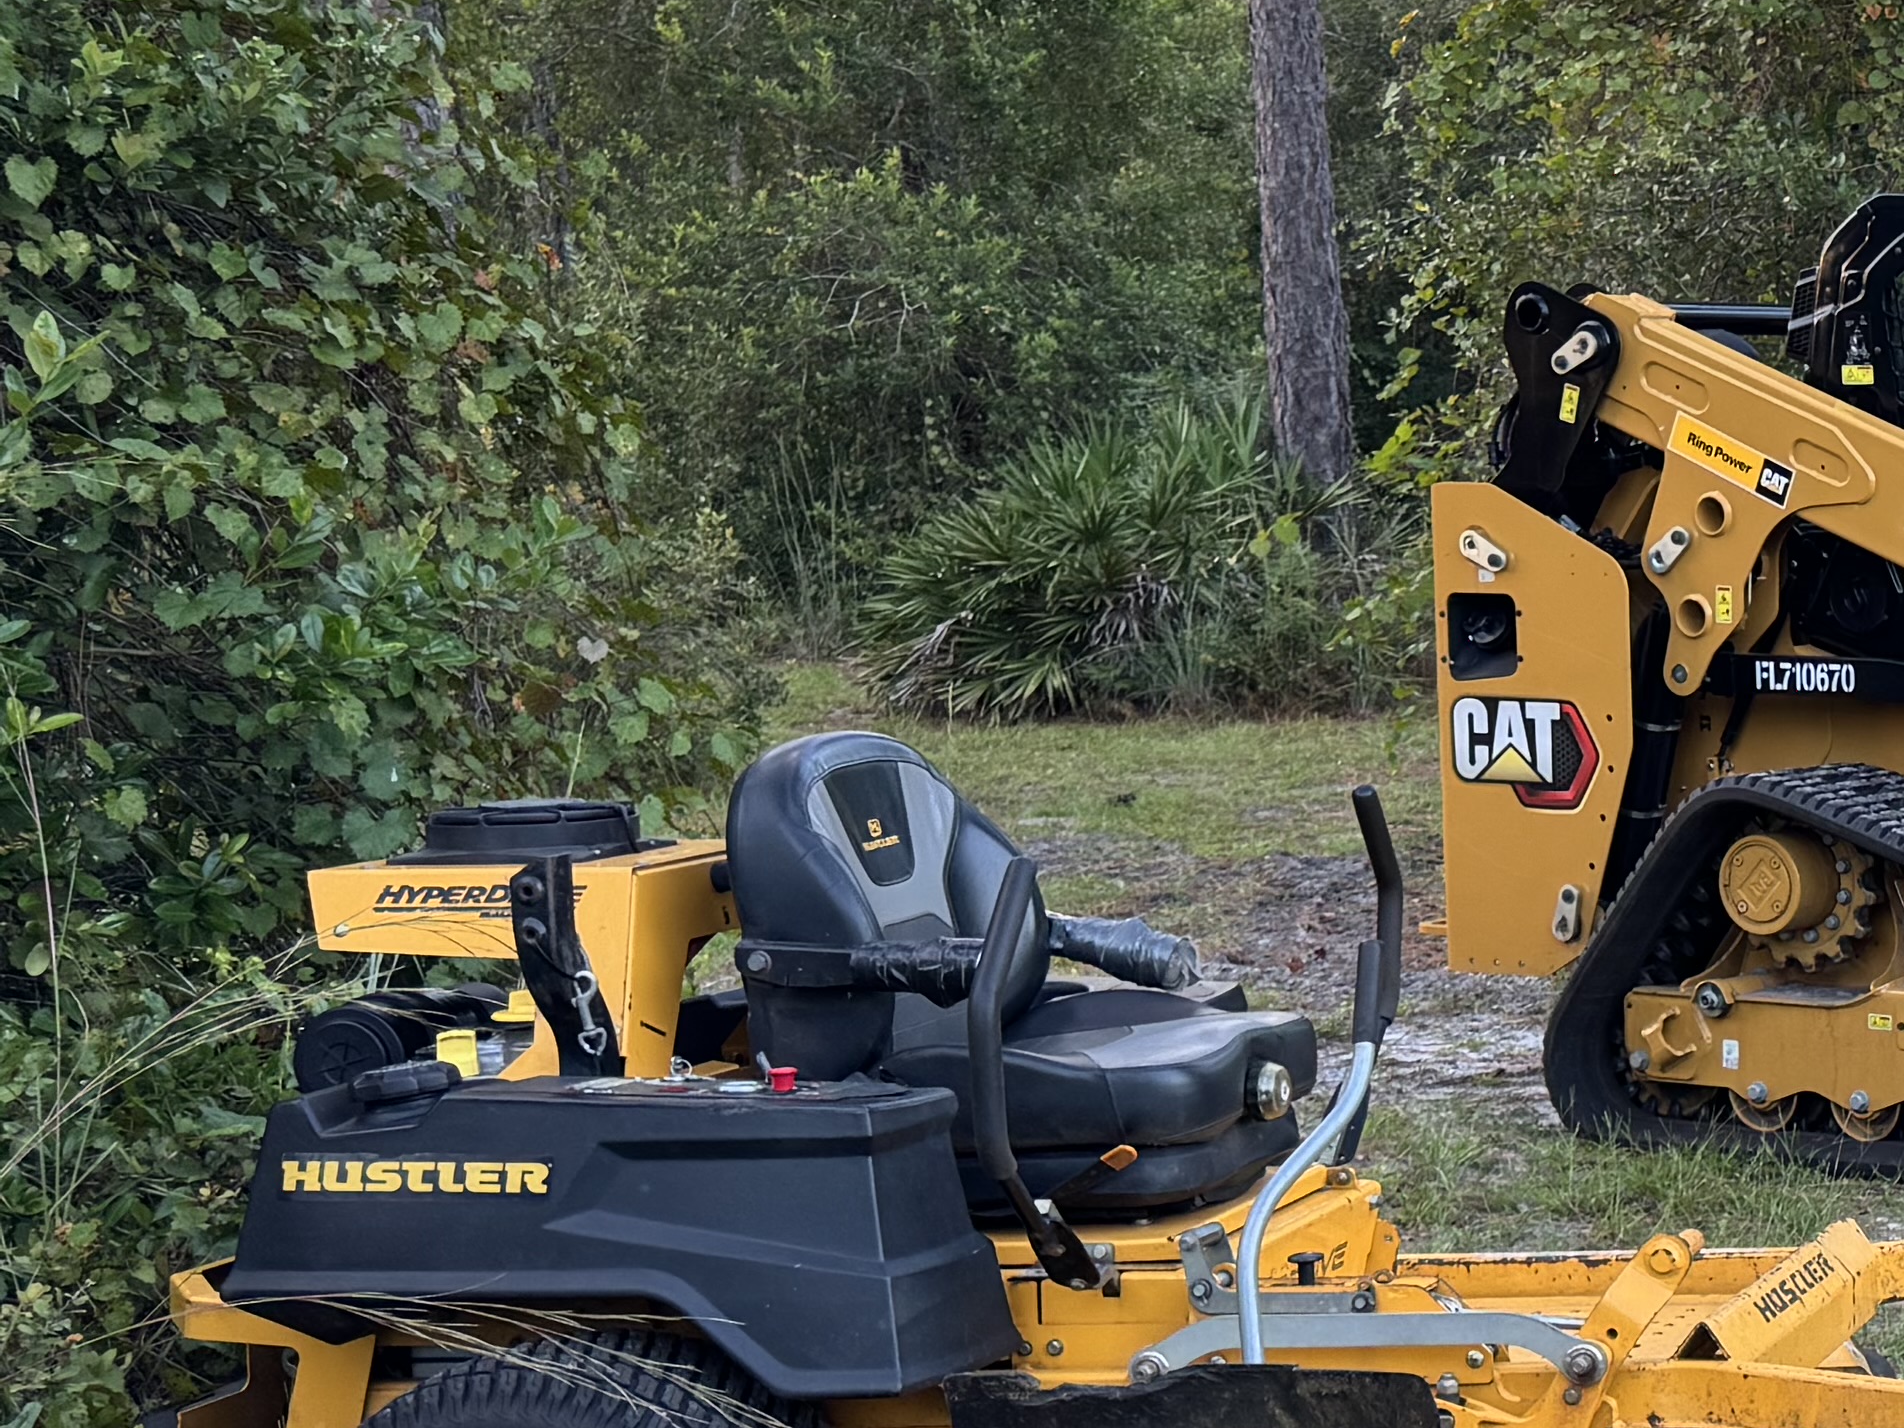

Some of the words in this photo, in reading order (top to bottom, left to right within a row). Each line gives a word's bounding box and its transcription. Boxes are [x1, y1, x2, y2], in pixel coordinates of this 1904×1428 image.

[1687, 432, 1714, 457] Ring
[1714, 446, 1753, 474] Power
[1760, 467, 1790, 496] CAT
[1755, 660, 1856, 693] FL710670
[1453, 697, 1561, 784] CAT
[375, 885, 588, 905] HYPERDE
[282, 1160, 548, 1193] HUSTLER
